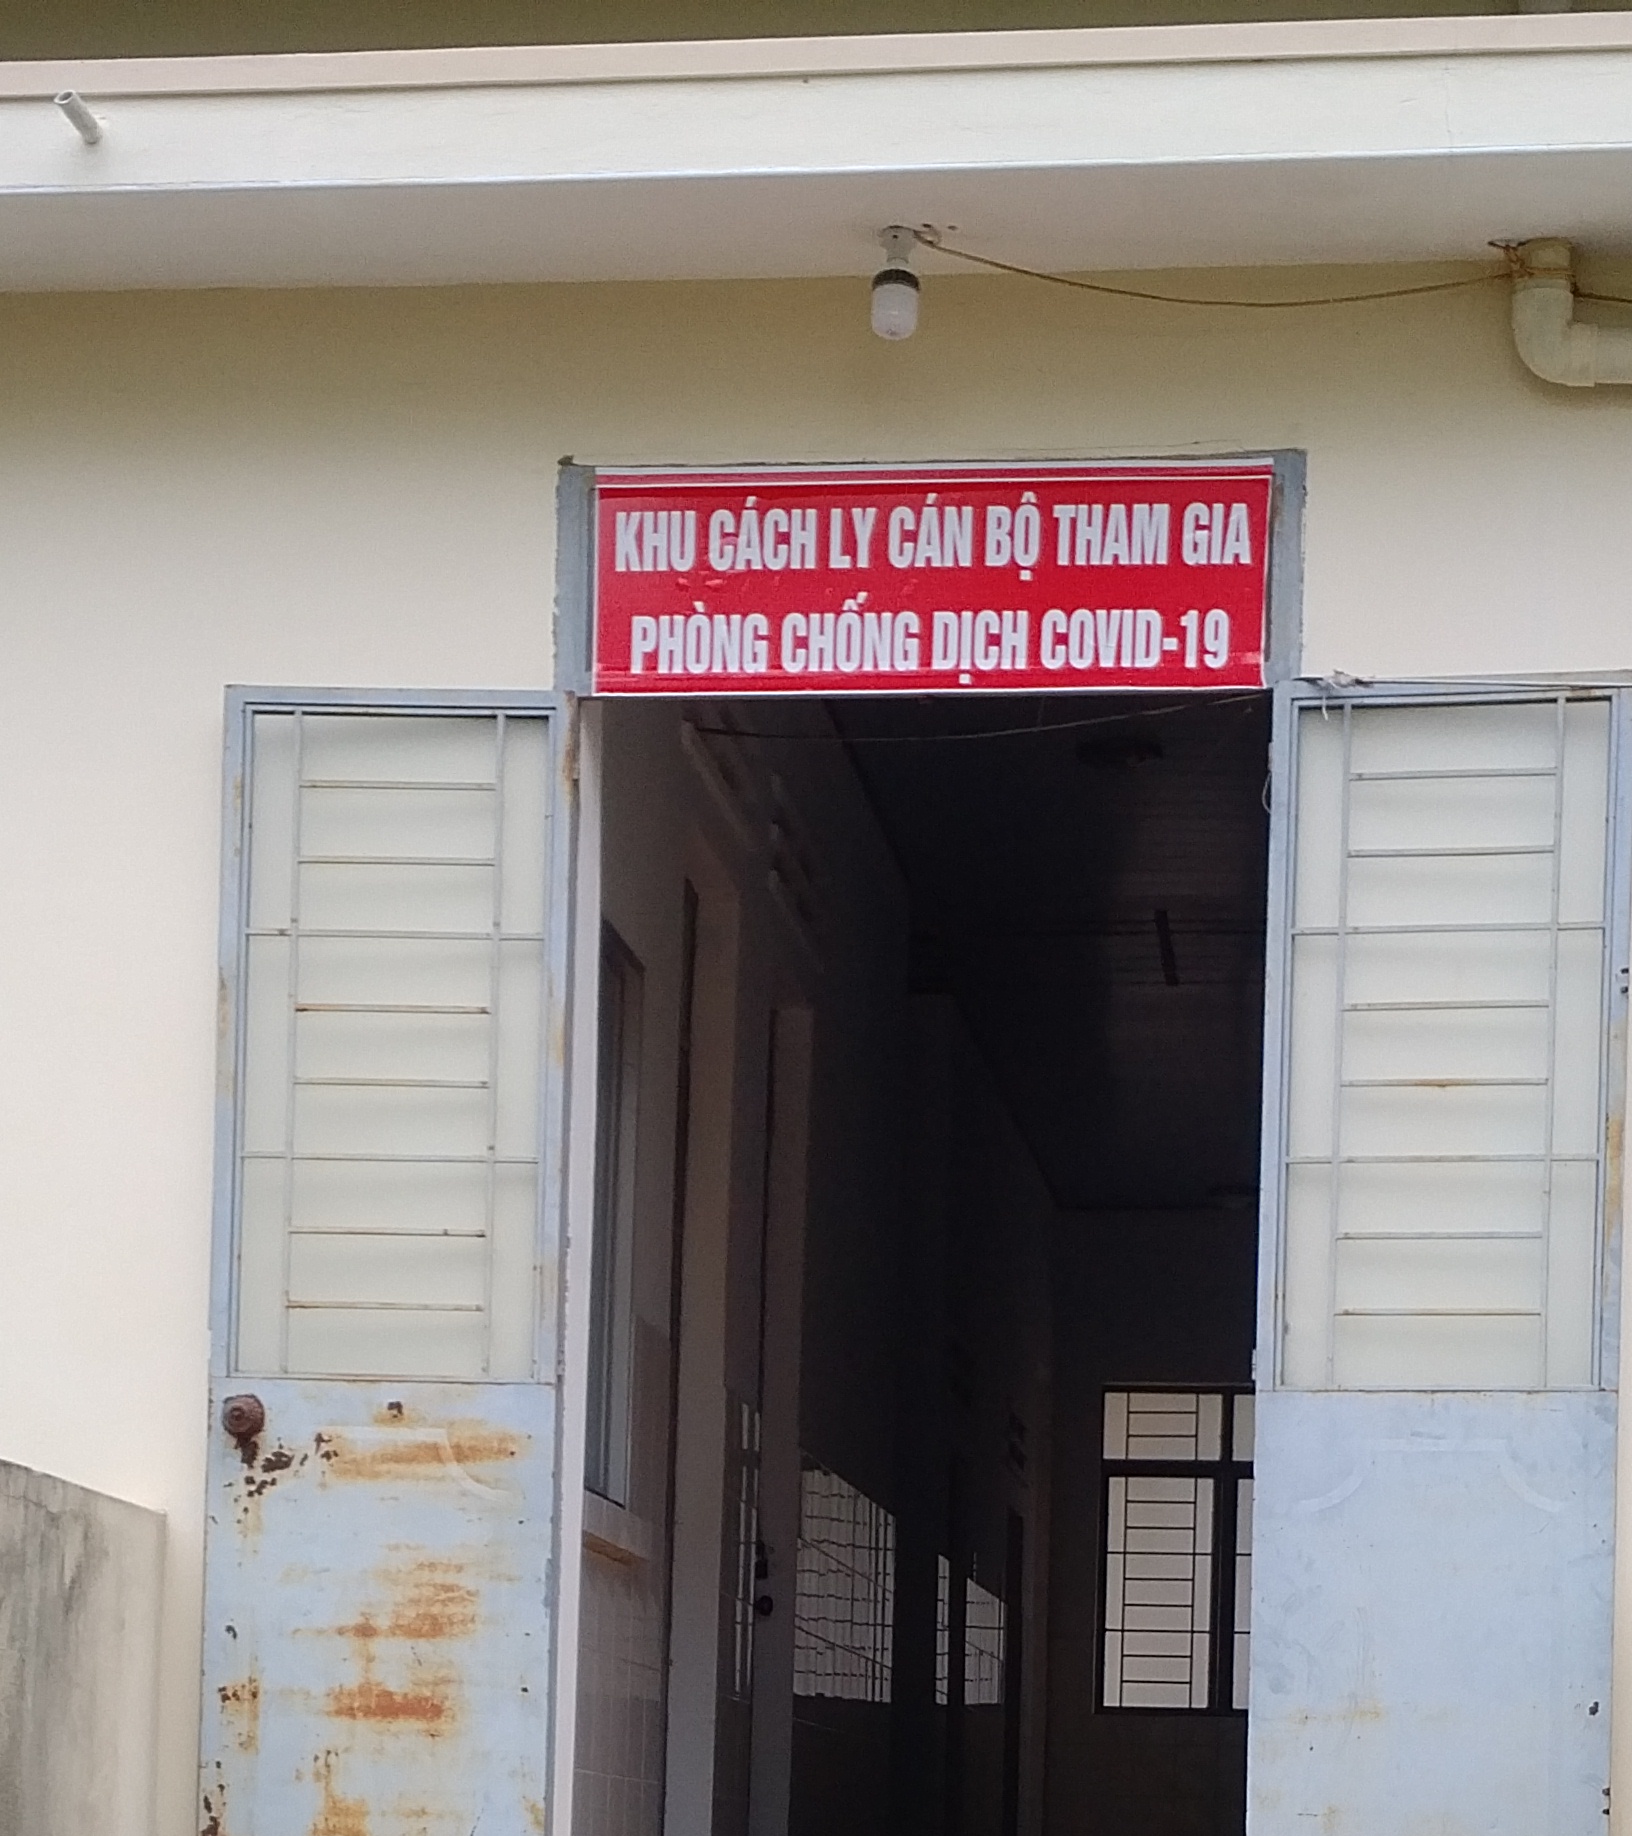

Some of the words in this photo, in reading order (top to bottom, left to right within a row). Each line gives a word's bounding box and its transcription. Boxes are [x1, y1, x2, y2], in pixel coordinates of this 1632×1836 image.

[615, 510, 696, 572] KHU
[708, 495, 818, 572] CÁCH
[829, 507, 877, 569] LY
[888, 492, 973, 568] CÁN
[984, 491, 1040, 581] BỘ
[1053, 503, 1170, 566] THAM
[1182, 502, 1251, 566] GIA
[630, 600, 769, 674] PHÒNG
[781, 591, 919, 673] CHỐNG
[931, 609, 1029, 685] DỊCH
[1040, 608, 1230, 670] COVID-19
